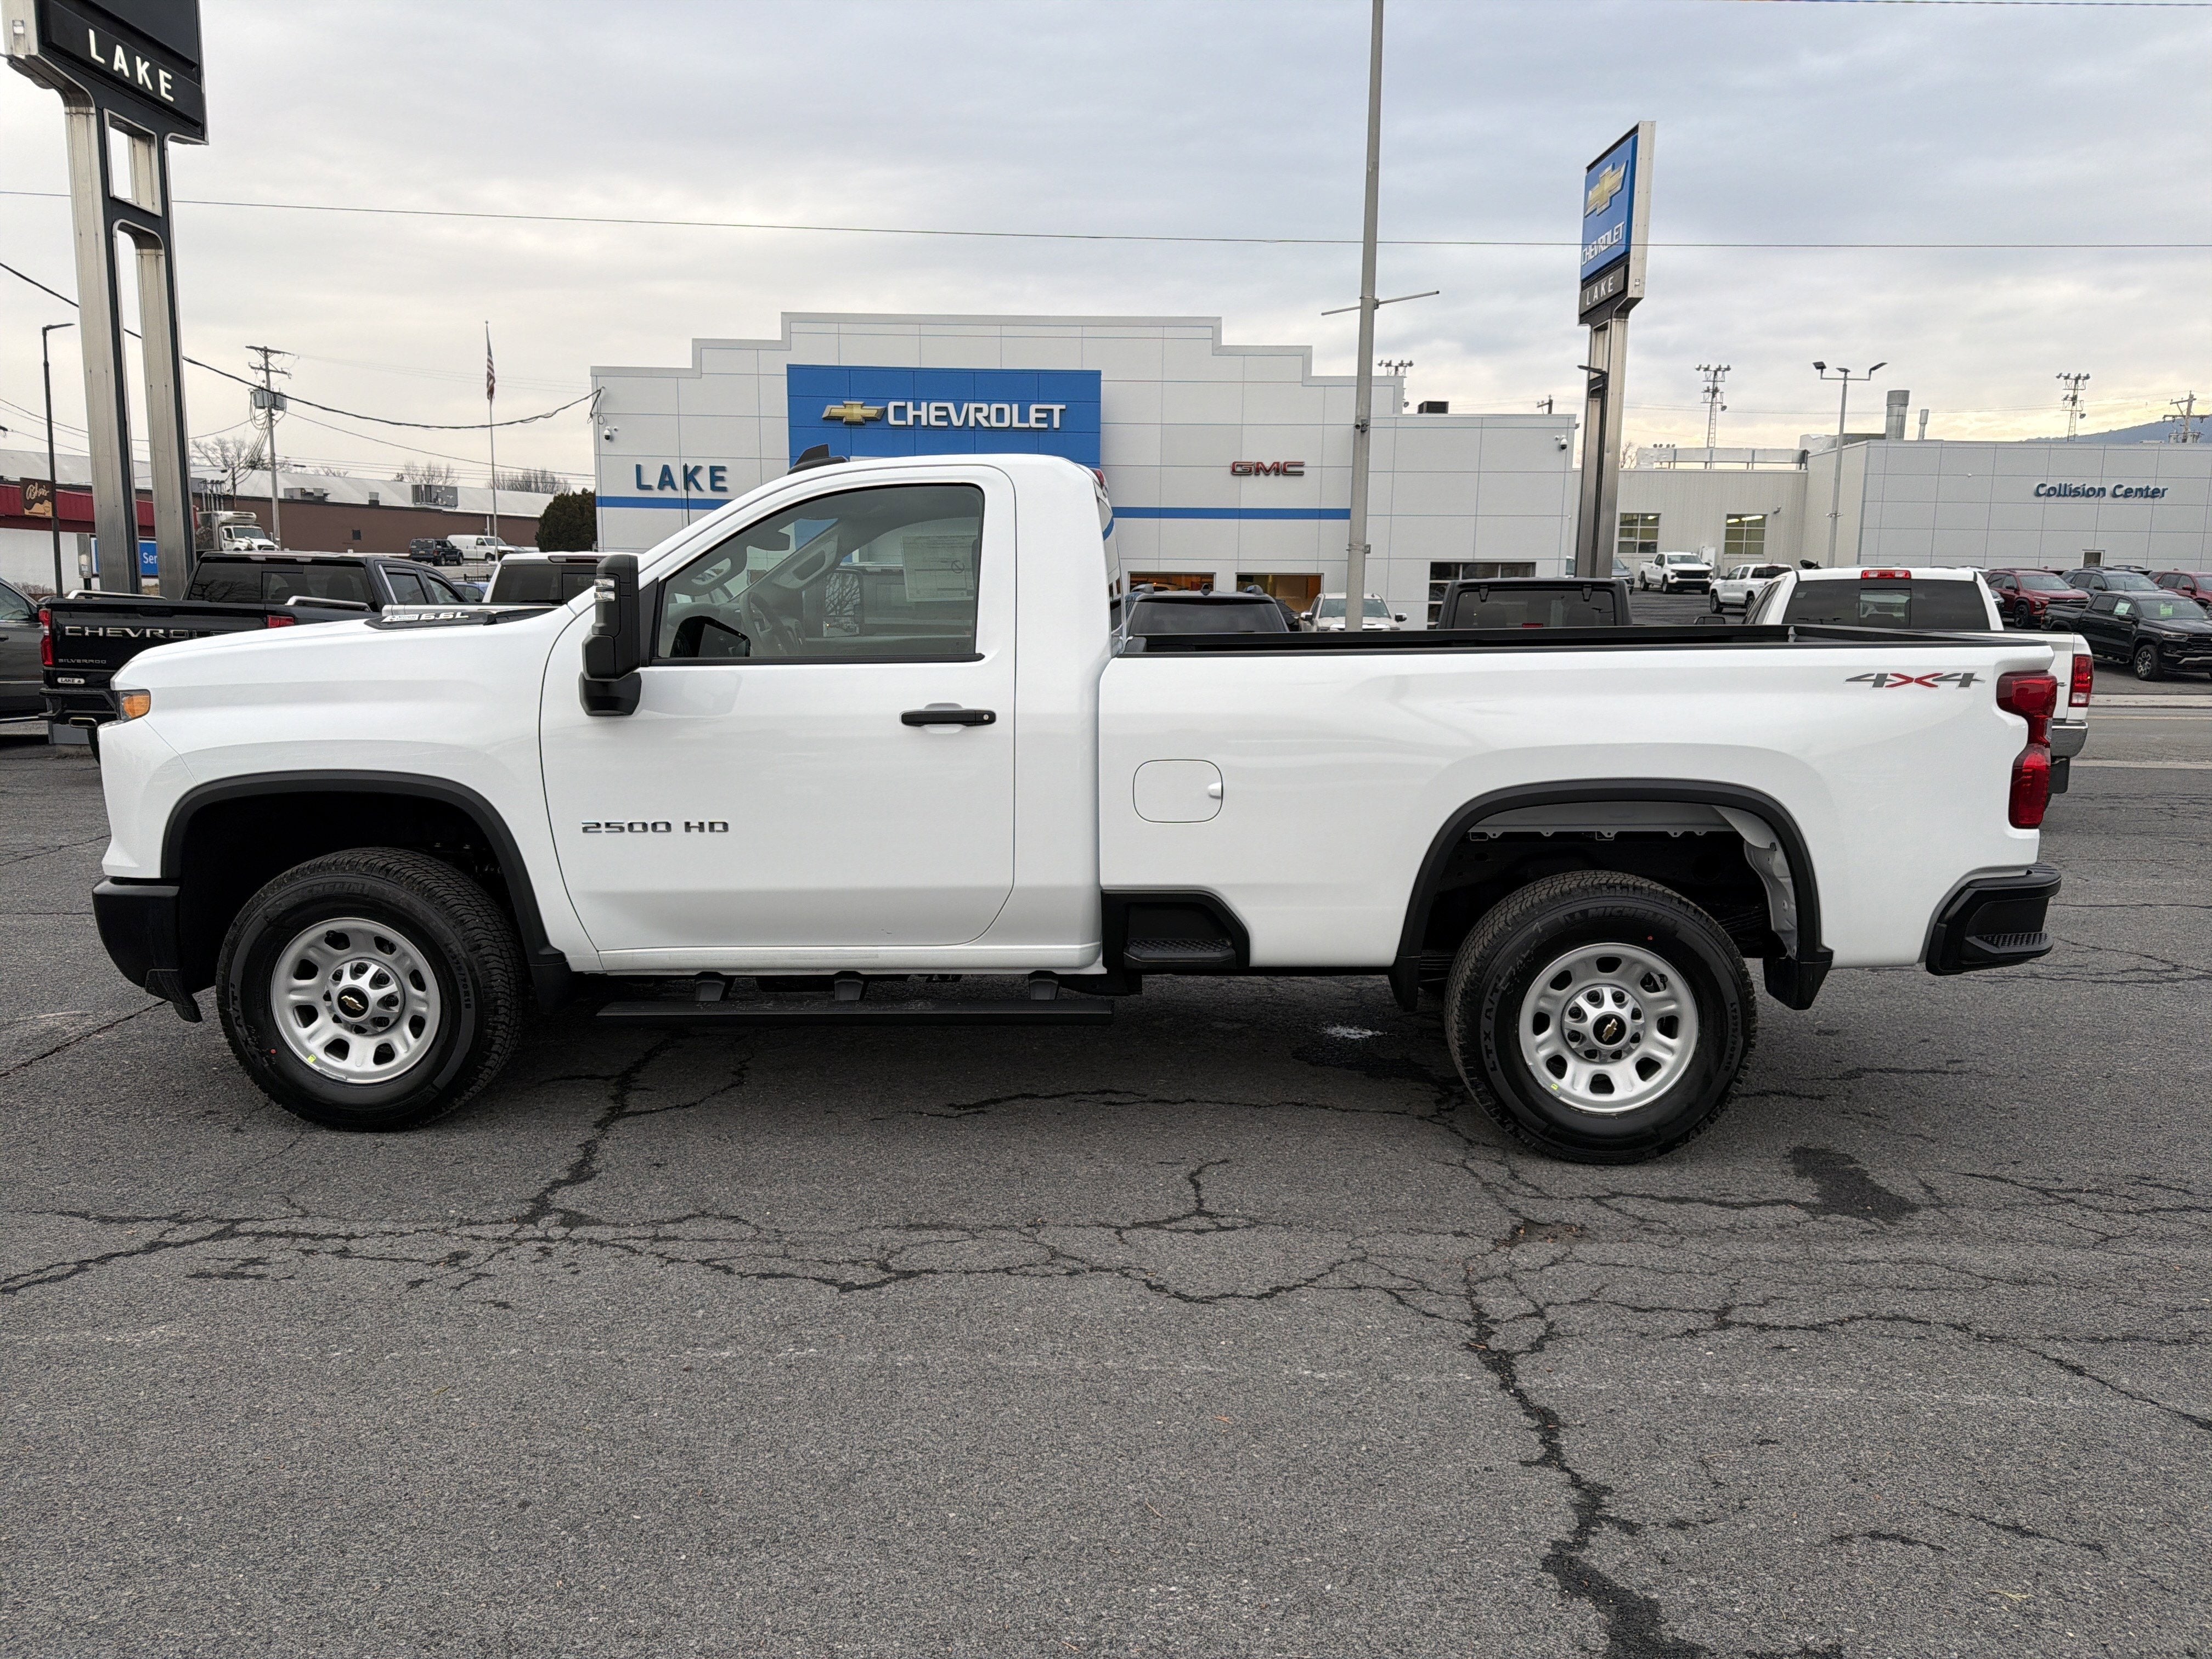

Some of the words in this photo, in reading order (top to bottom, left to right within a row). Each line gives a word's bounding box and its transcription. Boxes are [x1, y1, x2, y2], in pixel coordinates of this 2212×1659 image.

[88, 28, 174, 102] LAKE
[1581, 221, 1625, 266] CHEVROLET
[1586, 276, 1614, 306] LAKE
[888, 401, 1066, 428] CHEVROLET
[635, 464, 728, 492] LAKE
[1231, 461, 1305, 476] GMC
[2034, 483, 2107, 498] Collision
[2111, 484, 2169, 498] Center
[419, 612, 469, 620] 6.6L
[65, 626, 236, 639] CHEVROL
[582, 821, 672, 833] 2500
[684, 821, 729, 833] HD
[1483, 1030, 1498, 1072] LTX
